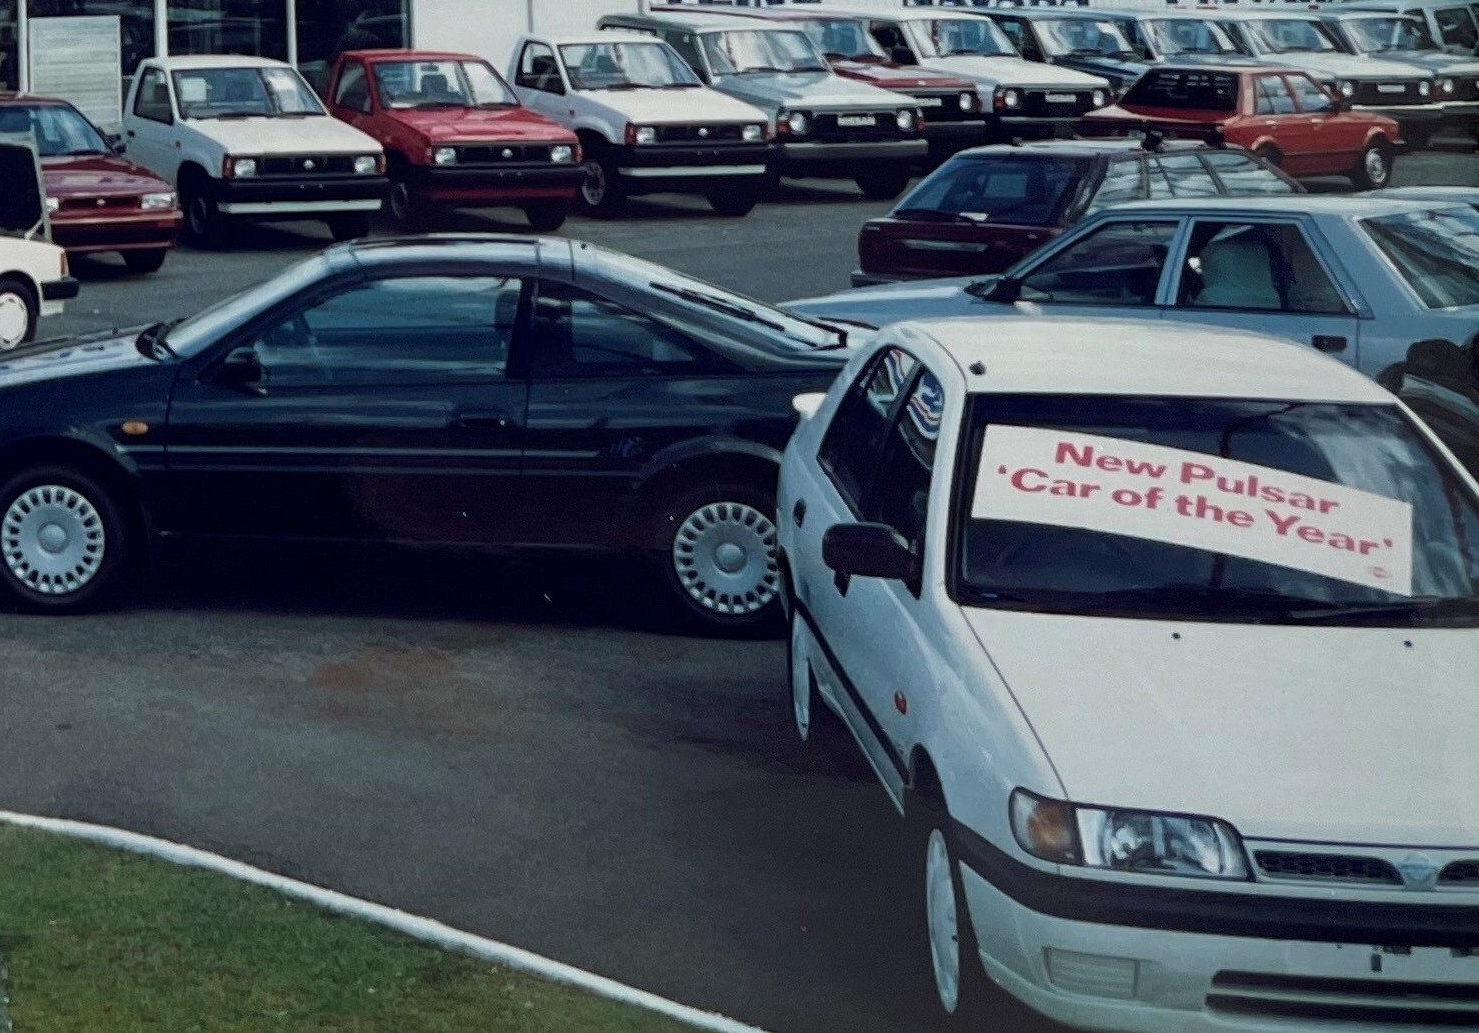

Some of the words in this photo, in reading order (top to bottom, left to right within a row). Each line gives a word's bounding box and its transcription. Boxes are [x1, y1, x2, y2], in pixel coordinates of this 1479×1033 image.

[1054, 442, 1167, 479] New
[1179, 461, 1340, 514] Pulsar
[1111, 487, 1165, 510] of
[1174, 494, 1255, 527] the
